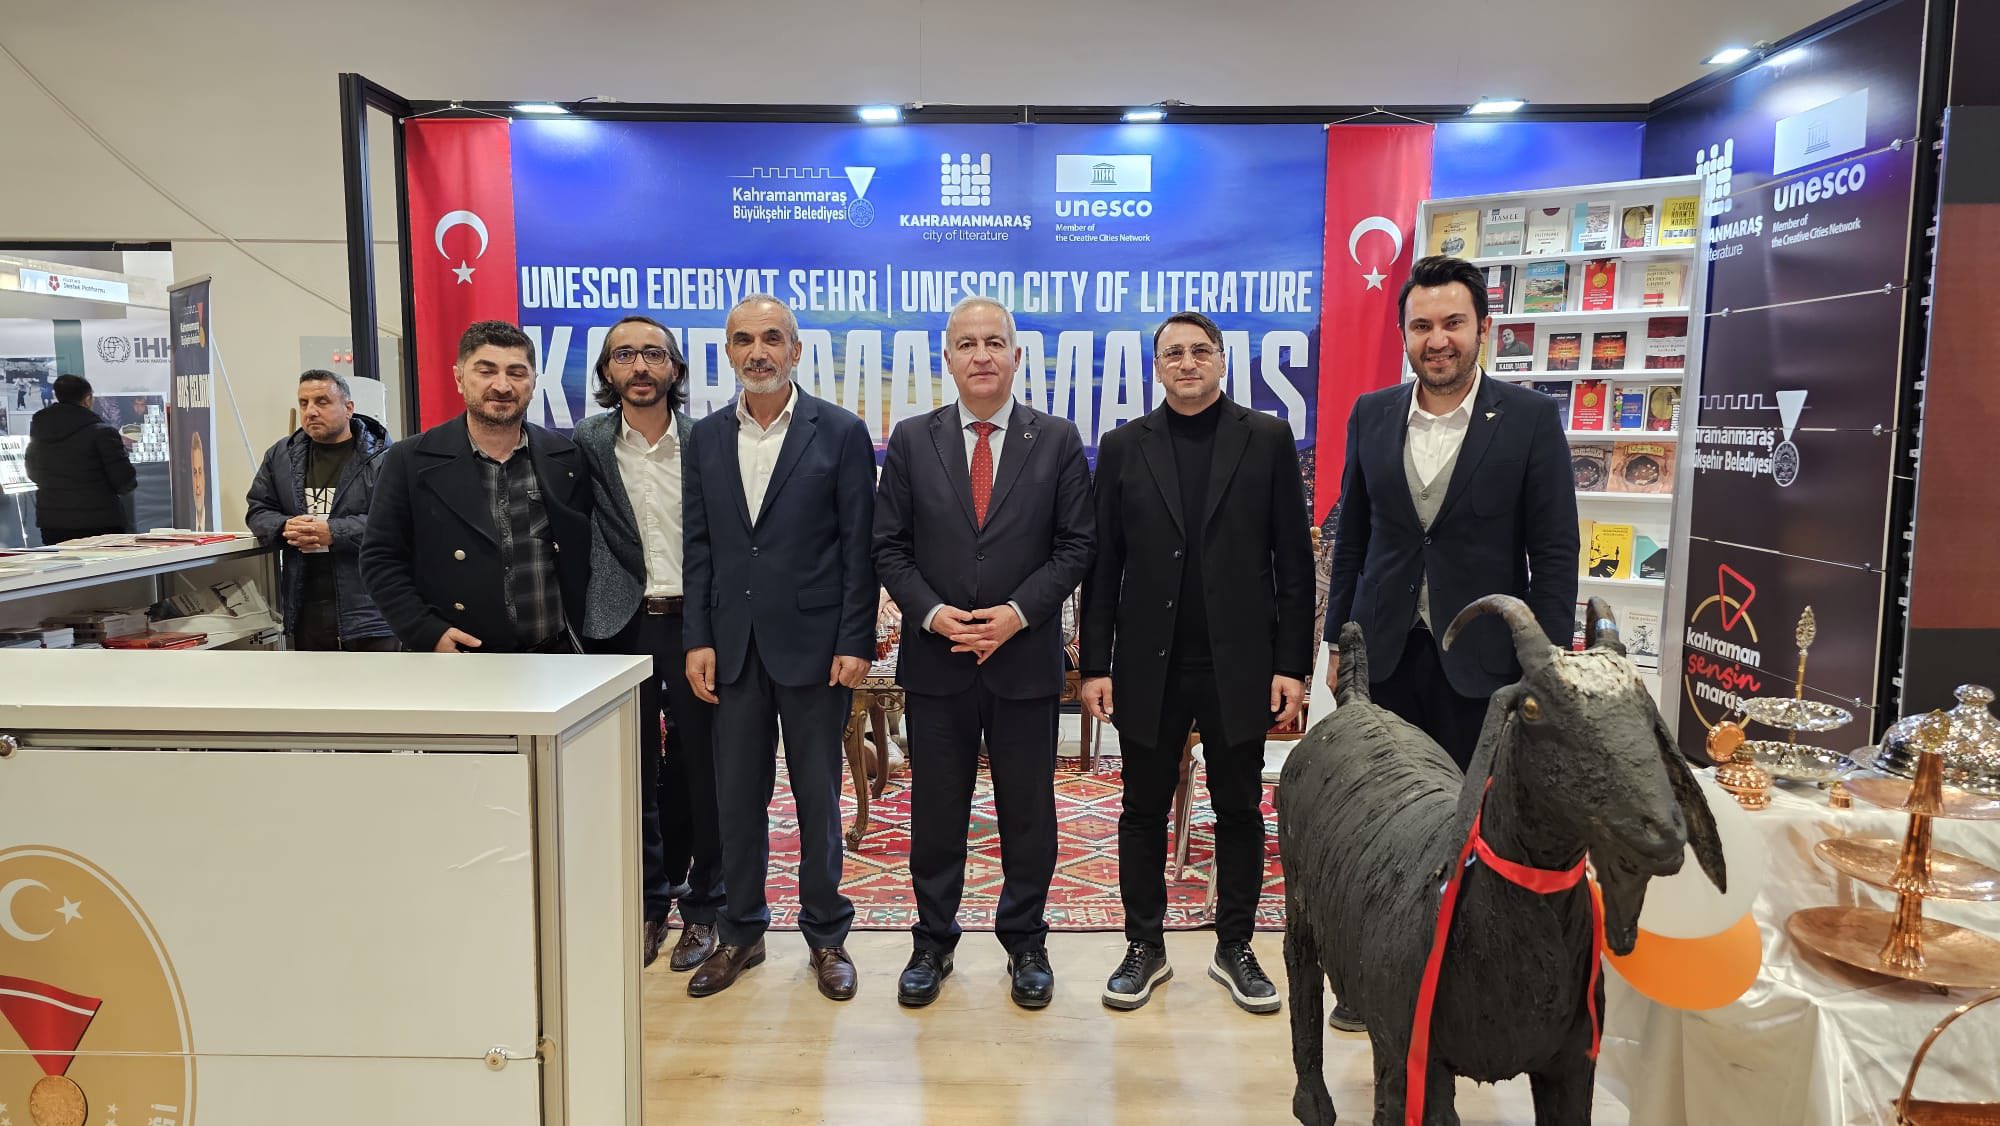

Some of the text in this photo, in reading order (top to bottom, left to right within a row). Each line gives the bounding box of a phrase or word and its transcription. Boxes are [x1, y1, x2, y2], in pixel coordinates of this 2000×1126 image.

[733, 187, 848, 206] Kahramanmaraş
[1773, 163, 1866, 212] unesco
[733, 205, 848, 223] Büyükşehir Belediyesi
[1055, 199, 1153, 218] unesco
[900, 214, 1032, 230] KAHRAMANMARAŞ
[1055, 223, 1096, 232] Member of
[1772, 214, 1809, 233] Member of
[923, 230, 1009, 242] city of literature
[1055, 234, 1151, 242] the Creative Cities Network
[1771, 217, 1862, 248] the Creative Cities Network
[520, 265, 639, 310] UNESCO
[901, 270, 1015, 313] UNESCO
[1023, 270, 1089, 313] CITY
[1095, 270, 1130, 313] OF
[1140, 270, 1314, 313] LITERATURE
[1724, 450, 1773, 478] Belediyesi
[1686, 626, 1761, 668] kahraman
[1696, 681, 1746, 717] maraş
